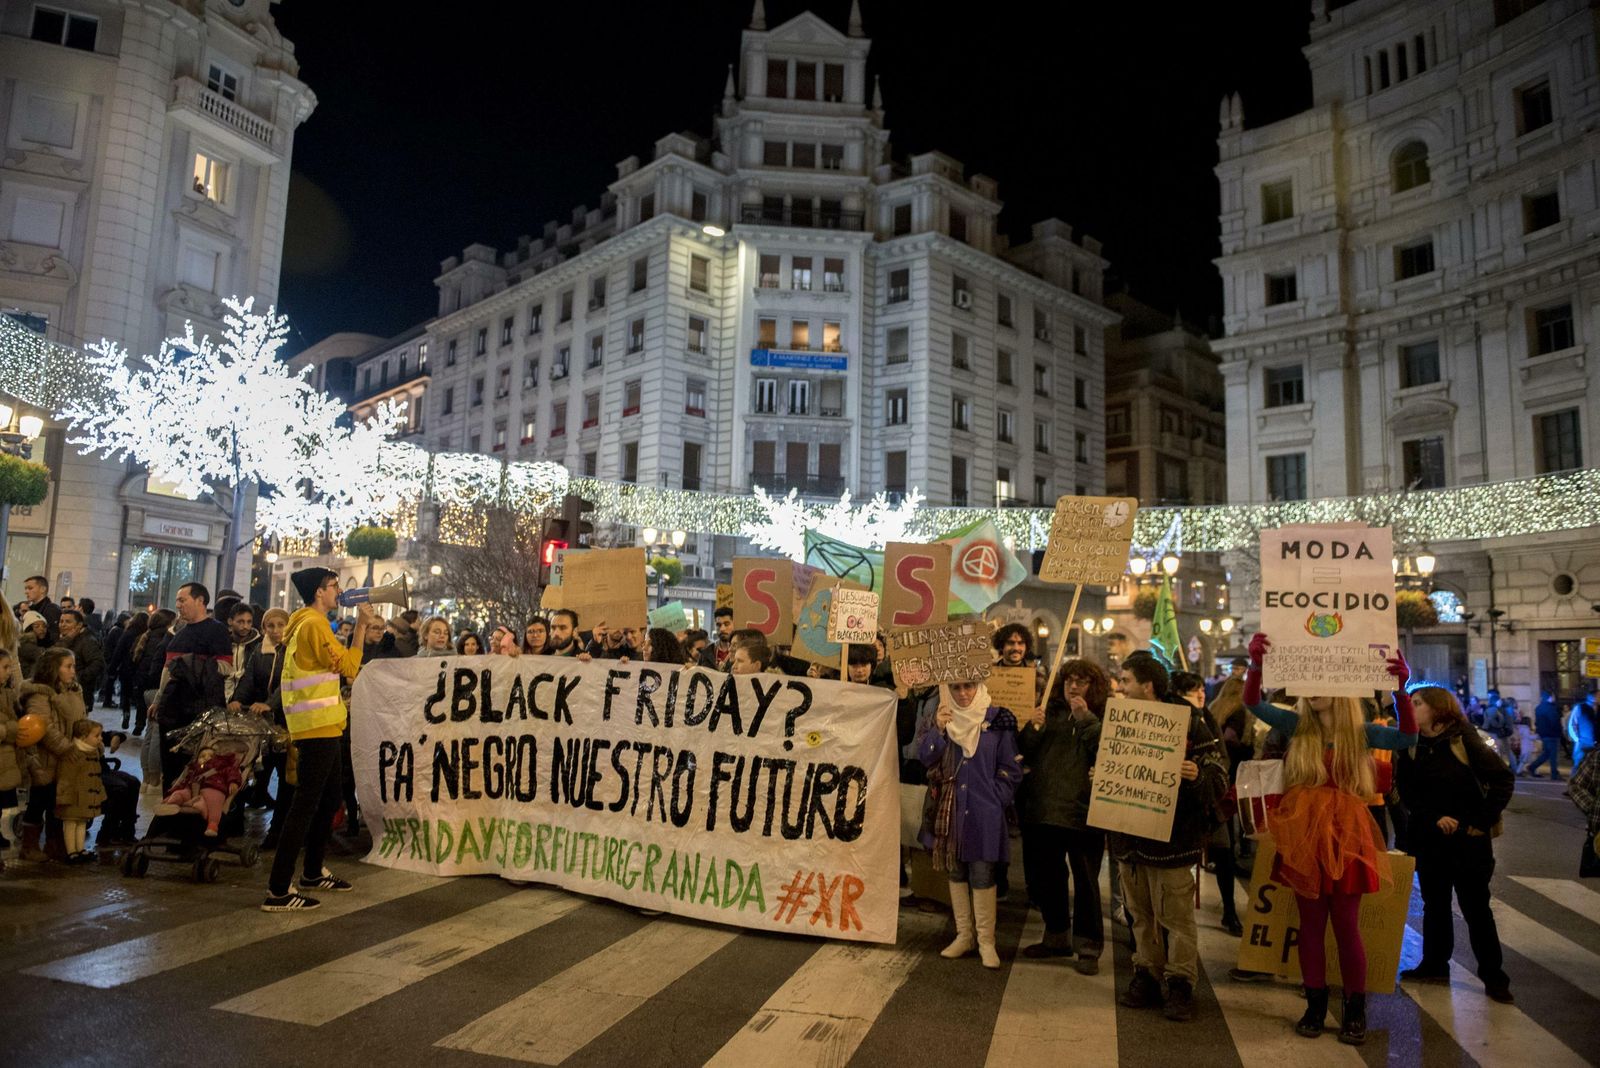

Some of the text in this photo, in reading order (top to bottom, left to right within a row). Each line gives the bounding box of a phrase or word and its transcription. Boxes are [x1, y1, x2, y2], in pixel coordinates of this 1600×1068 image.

[1281, 540, 1374, 560] MODA
[893, 554, 935, 627] S
[744, 568, 780, 637] S
[1265, 591, 1389, 611] ECOCIDIO
[930, 636, 988, 656] LLENAS
[1279, 644, 1330, 655] INDUSTRIA
[1333, 645, 1365, 656] TEXTIL
[894, 654, 968, 674] MENTES
[1278, 654, 1336, 664] RESPONSABLE
[1298, 663, 1311, 673] DE
[1312, 663, 1324, 673] LA
[1273, 671, 1308, 682] GLOBAL
[424, 660, 813, 751] ¿BLACK FRIDAY?
[1109, 708, 1141, 724] BLACK
[1115, 725, 1136, 739] PARA
[1131, 745, 1165, 761] ANFIBIOS
[1124, 763, 1177, 789] CORALES
[430, 734, 538, 803] NEGRO
[550, 736, 697, 828] NUESTRO
[705, 751, 869, 842] FUTURO
[772, 869, 865, 932] #XR
[1249, 923, 1273, 948] EL
